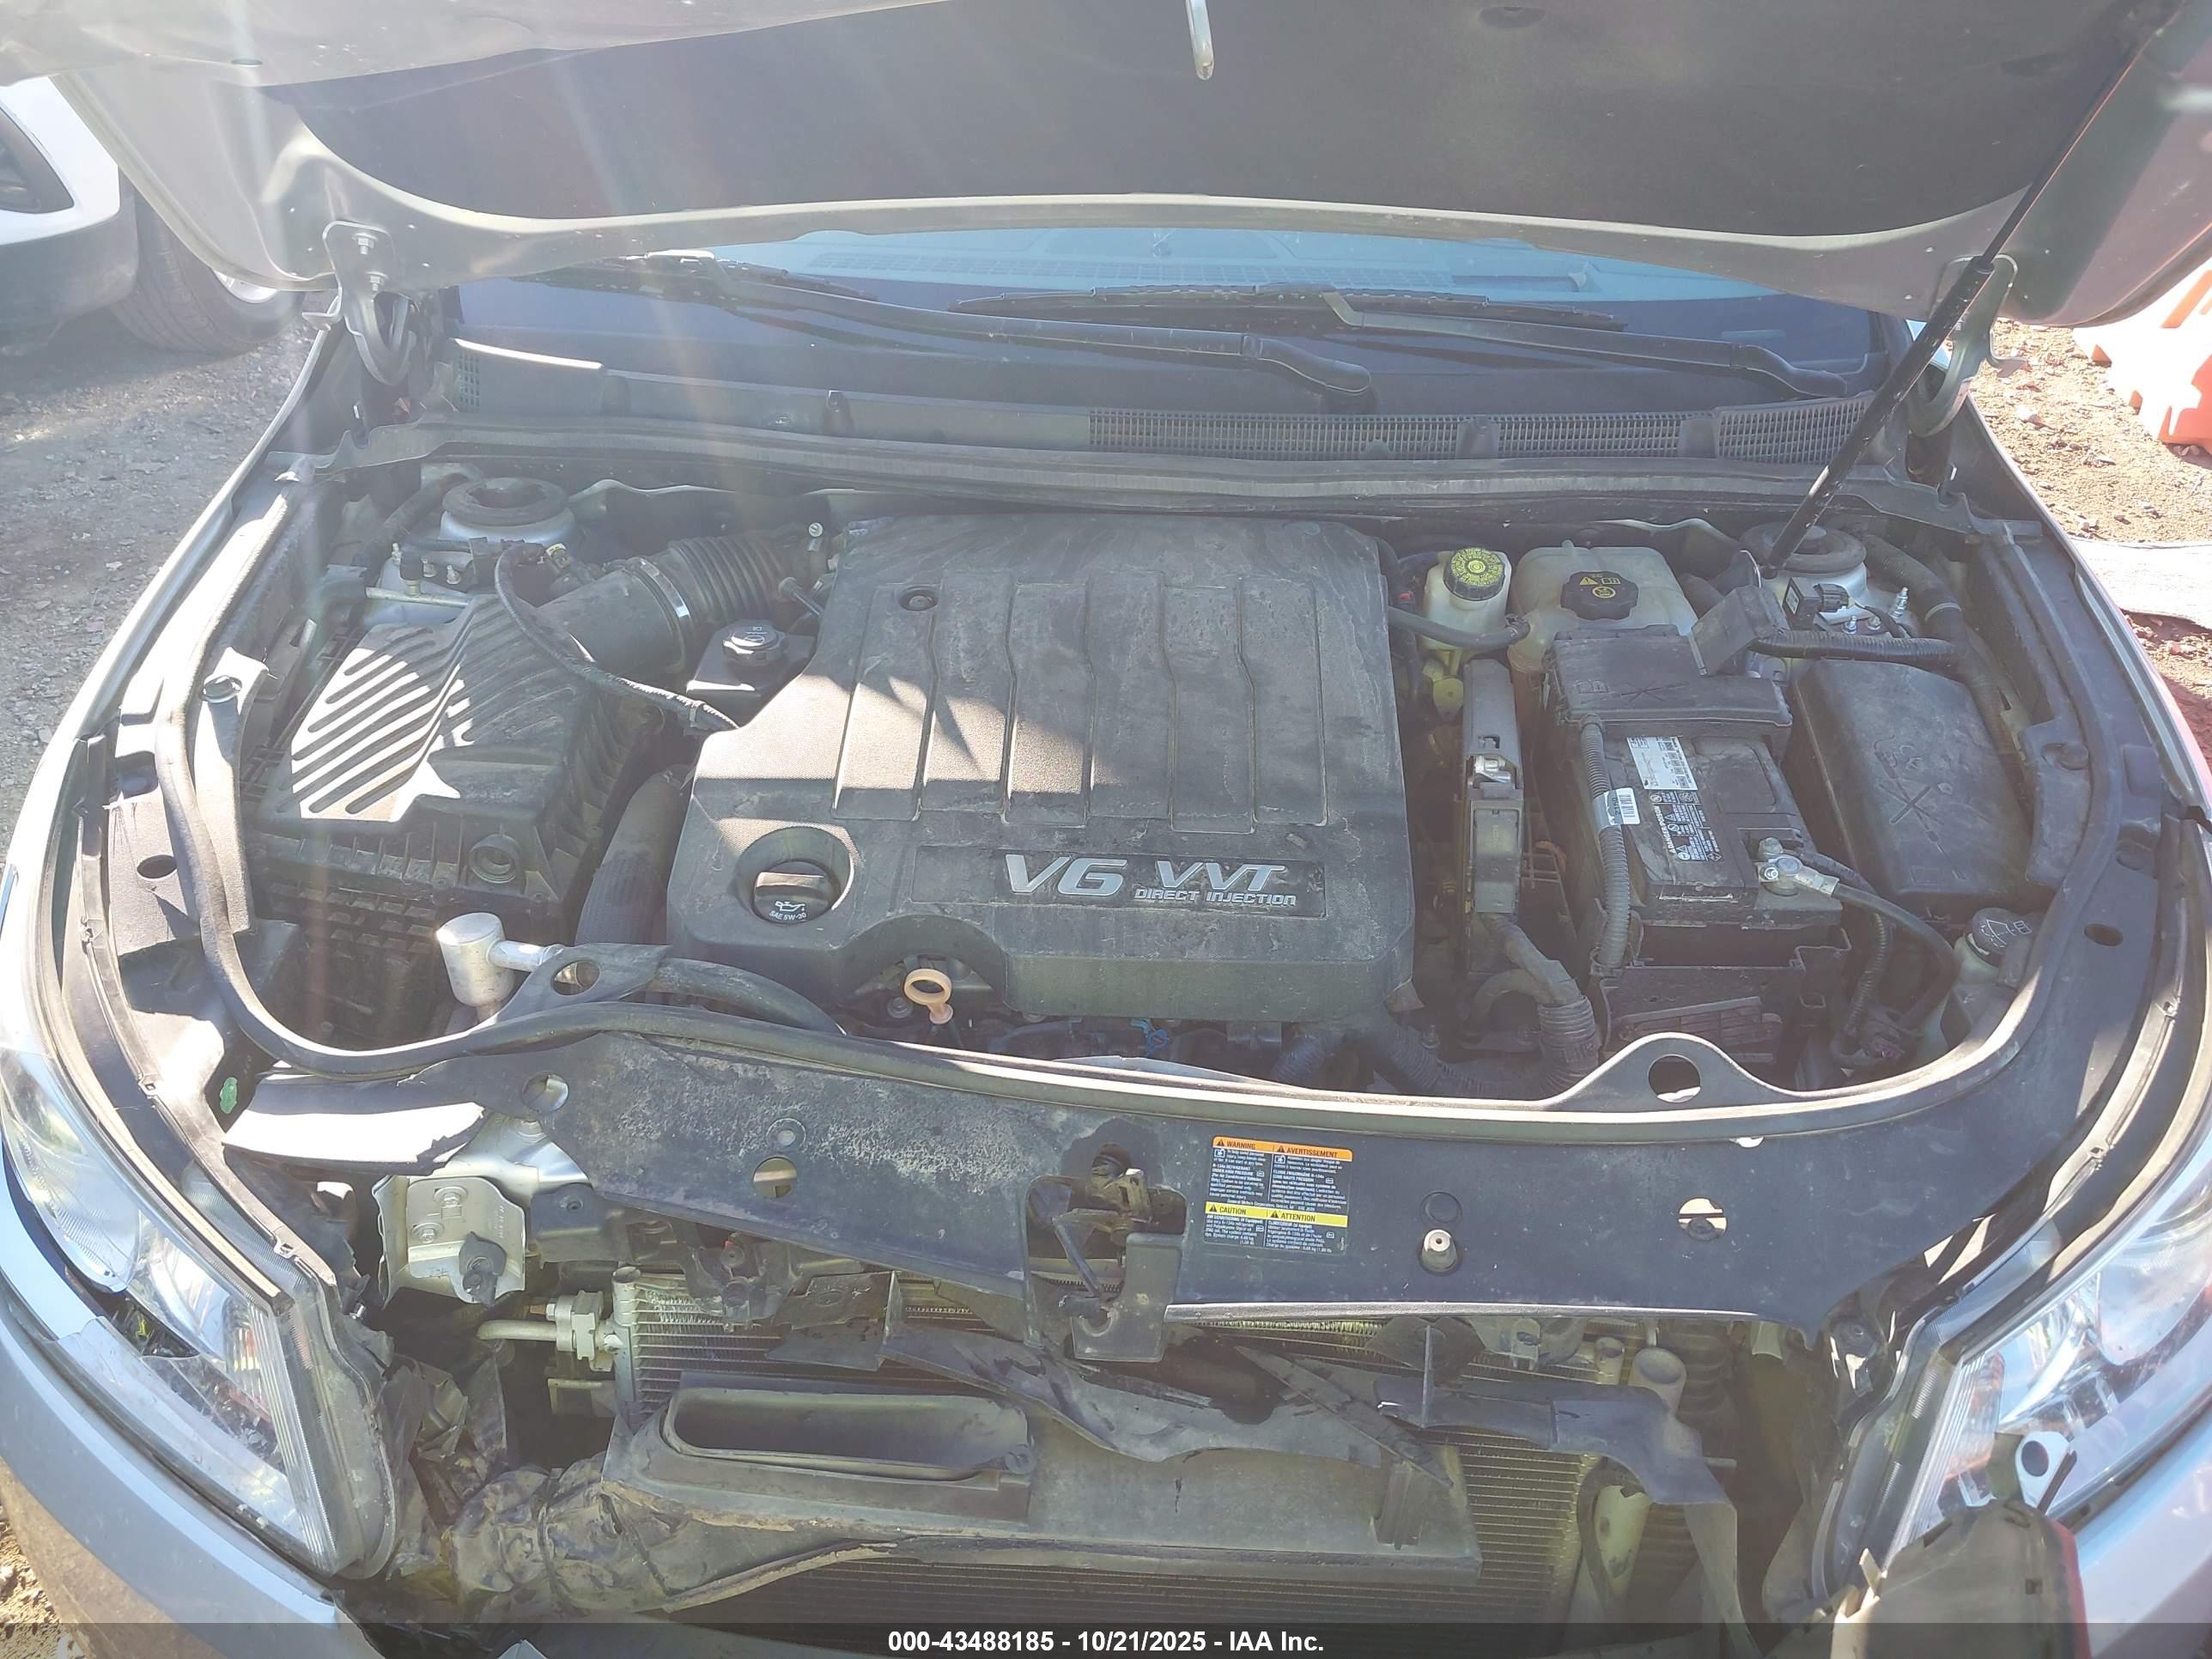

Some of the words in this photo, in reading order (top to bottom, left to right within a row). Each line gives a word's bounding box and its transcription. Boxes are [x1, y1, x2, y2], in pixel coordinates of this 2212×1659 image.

[1005, 854, 1127, 896] V6
[1155, 860, 1286, 891] VVT
[1134, 888, 1200, 902] DIRECT
[1206, 890, 1297, 906] INJECTION
[769, 910, 782, 921] SAE
[783, 912, 807, 921] 5W-30
[1226, 1140, 1256, 1150] WARNING
[1287, 1147, 1339, 1158] AVERTISSEMENT
[1219, 1206, 1247, 1216] CAUTION
[1280, 1212, 1316, 1222] ATTENTION
